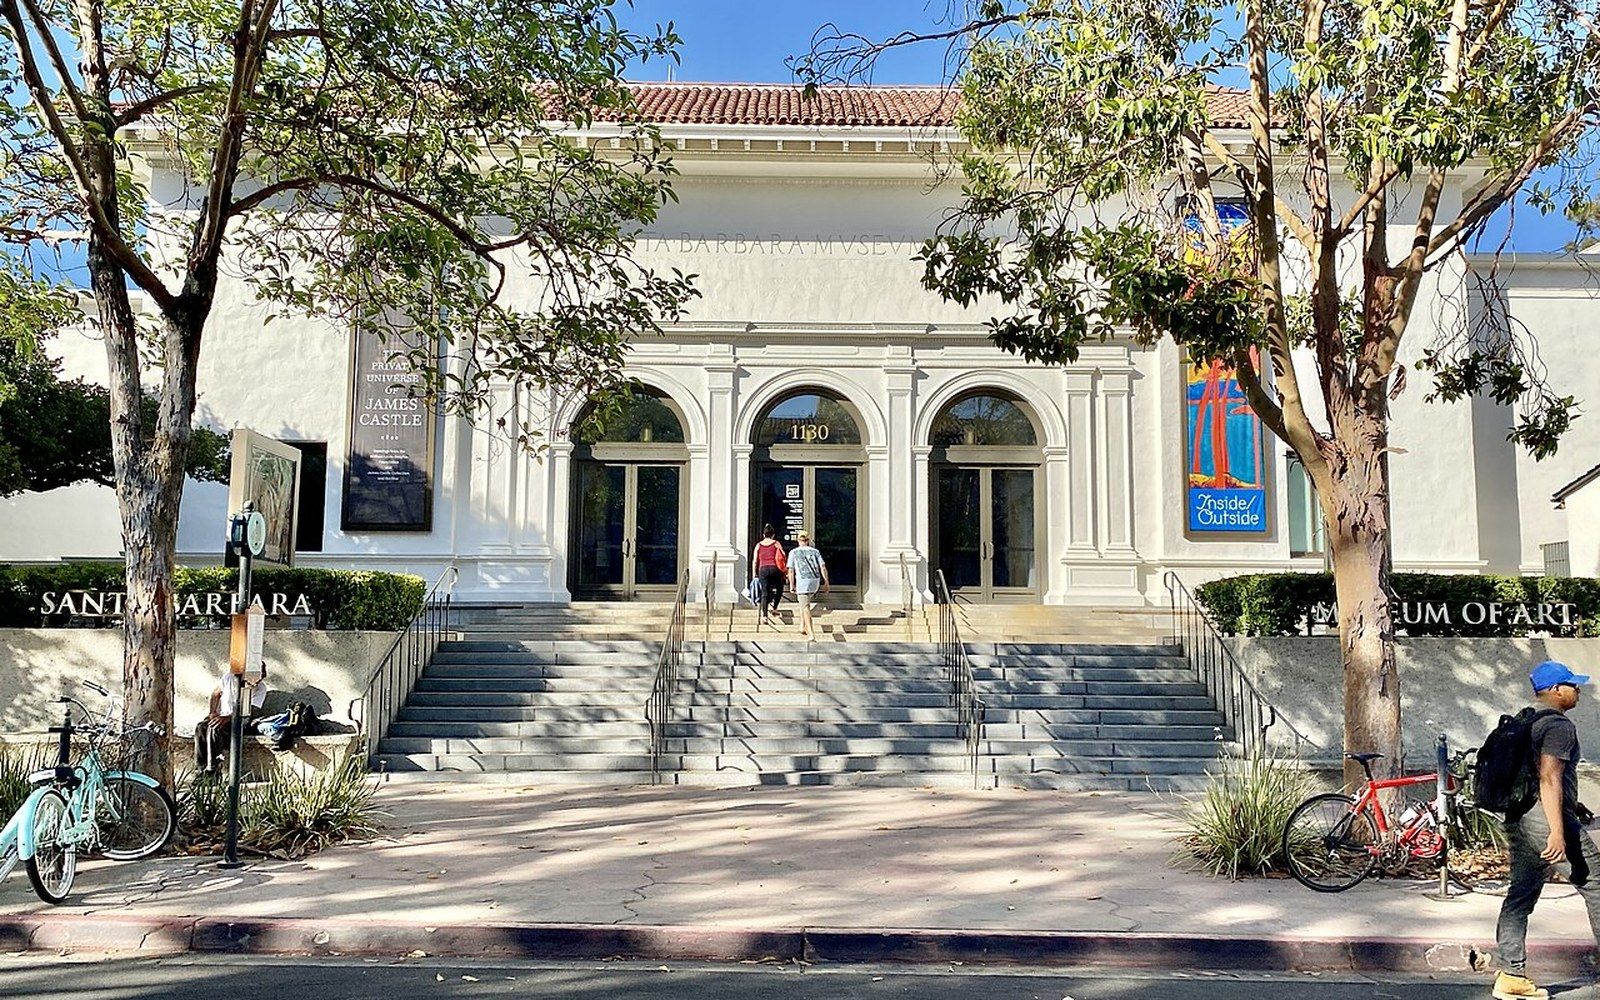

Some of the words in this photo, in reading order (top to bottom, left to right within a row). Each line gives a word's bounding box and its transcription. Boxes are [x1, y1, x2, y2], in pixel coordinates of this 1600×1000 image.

[679, 232, 808, 255] BARBARA
[371, 362, 411, 370] PRIVAT
[367, 374, 419, 382] UNIVERSE
[385, 386, 400, 394] OF
[365, 398, 418, 410] JAMES
[360, 414, 422, 426] CASTLE
[791, 424, 829, 440] 1130
[1196, 494, 1257, 510] Inside/
[1198, 508, 1260, 525] Outside
[41, 592, 127, 615] SANT
[174, 593, 313, 615] ARARA
[1315, 602, 1451, 625] MUM
[1462, 602, 1503, 625] OF
[1514, 601, 1577, 626] ART
